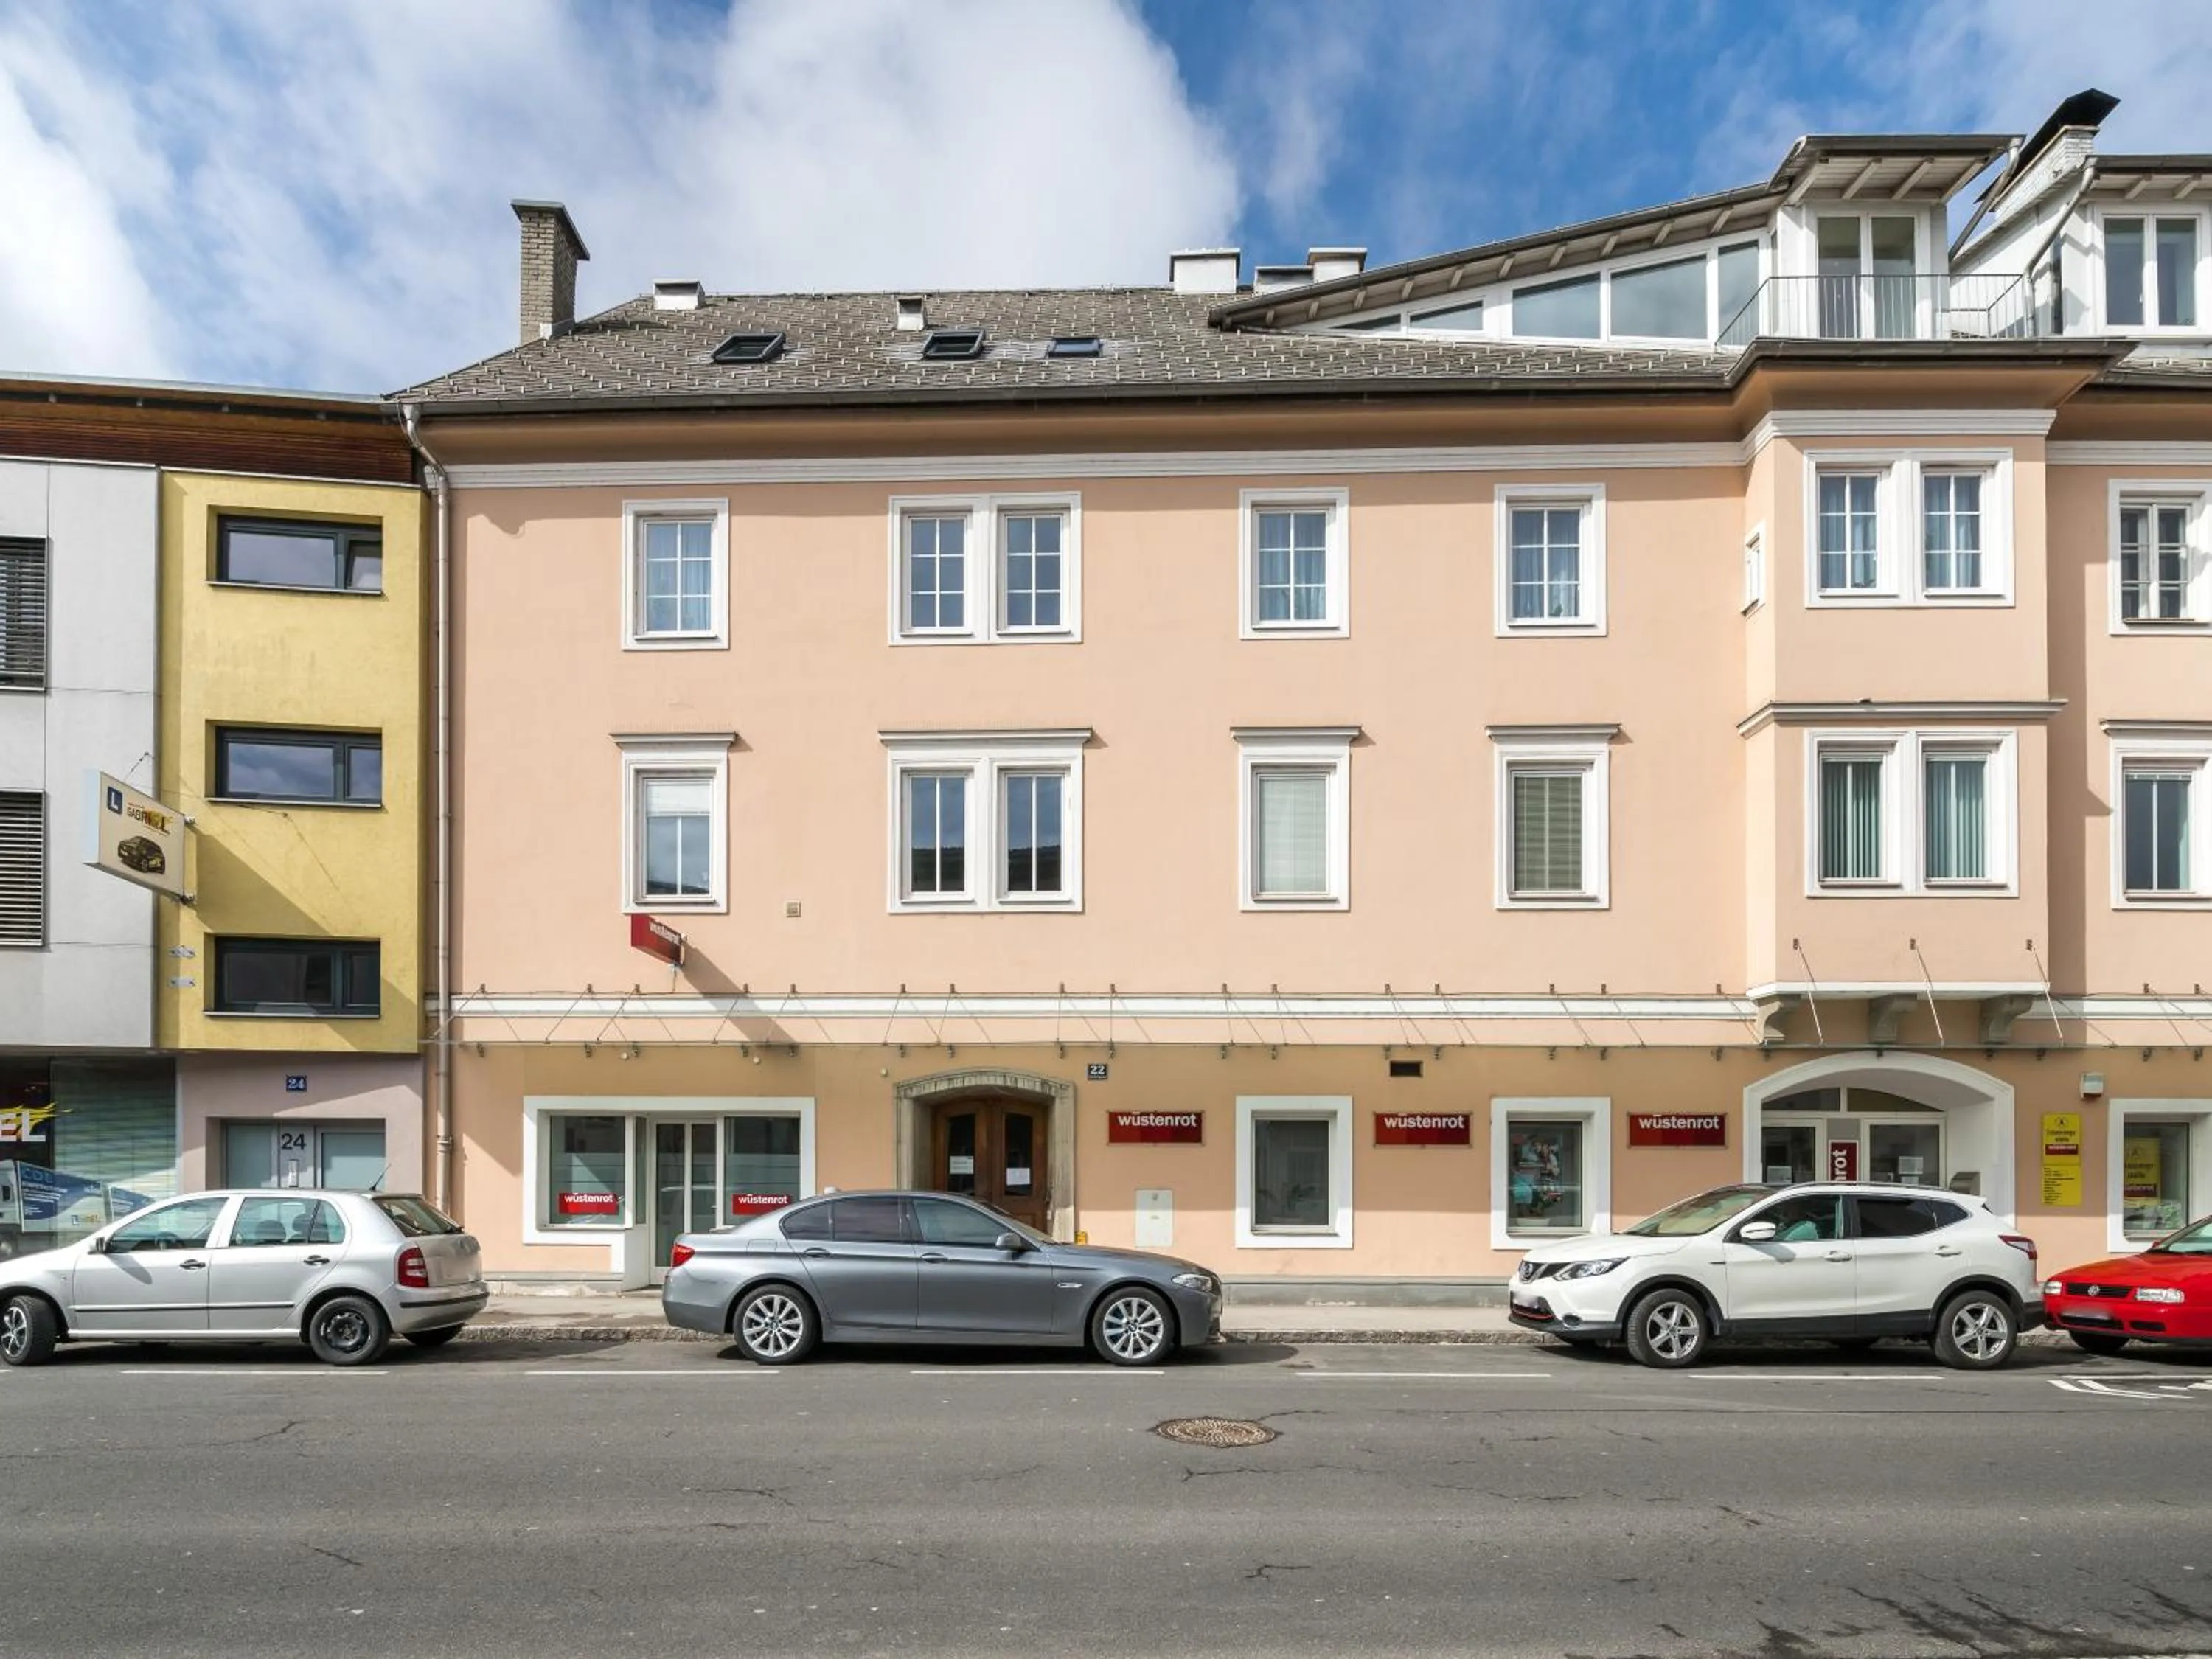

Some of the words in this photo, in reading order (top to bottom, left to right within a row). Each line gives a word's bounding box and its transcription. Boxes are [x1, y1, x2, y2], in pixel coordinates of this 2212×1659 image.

[1091, 1065, 1105, 1074] 22
[288, 1079, 305, 1089] 24
[1117, 1111, 1197, 1127] wüstenrot
[1384, 1112, 1464, 1129] wüstenrot
[1638, 1114, 1720, 1129] wüstenrot
[281, 1133, 307, 1150] 24
[563, 1192, 613, 1203] wüstenrot
[738, 1194, 788, 1204] wüstenrot
